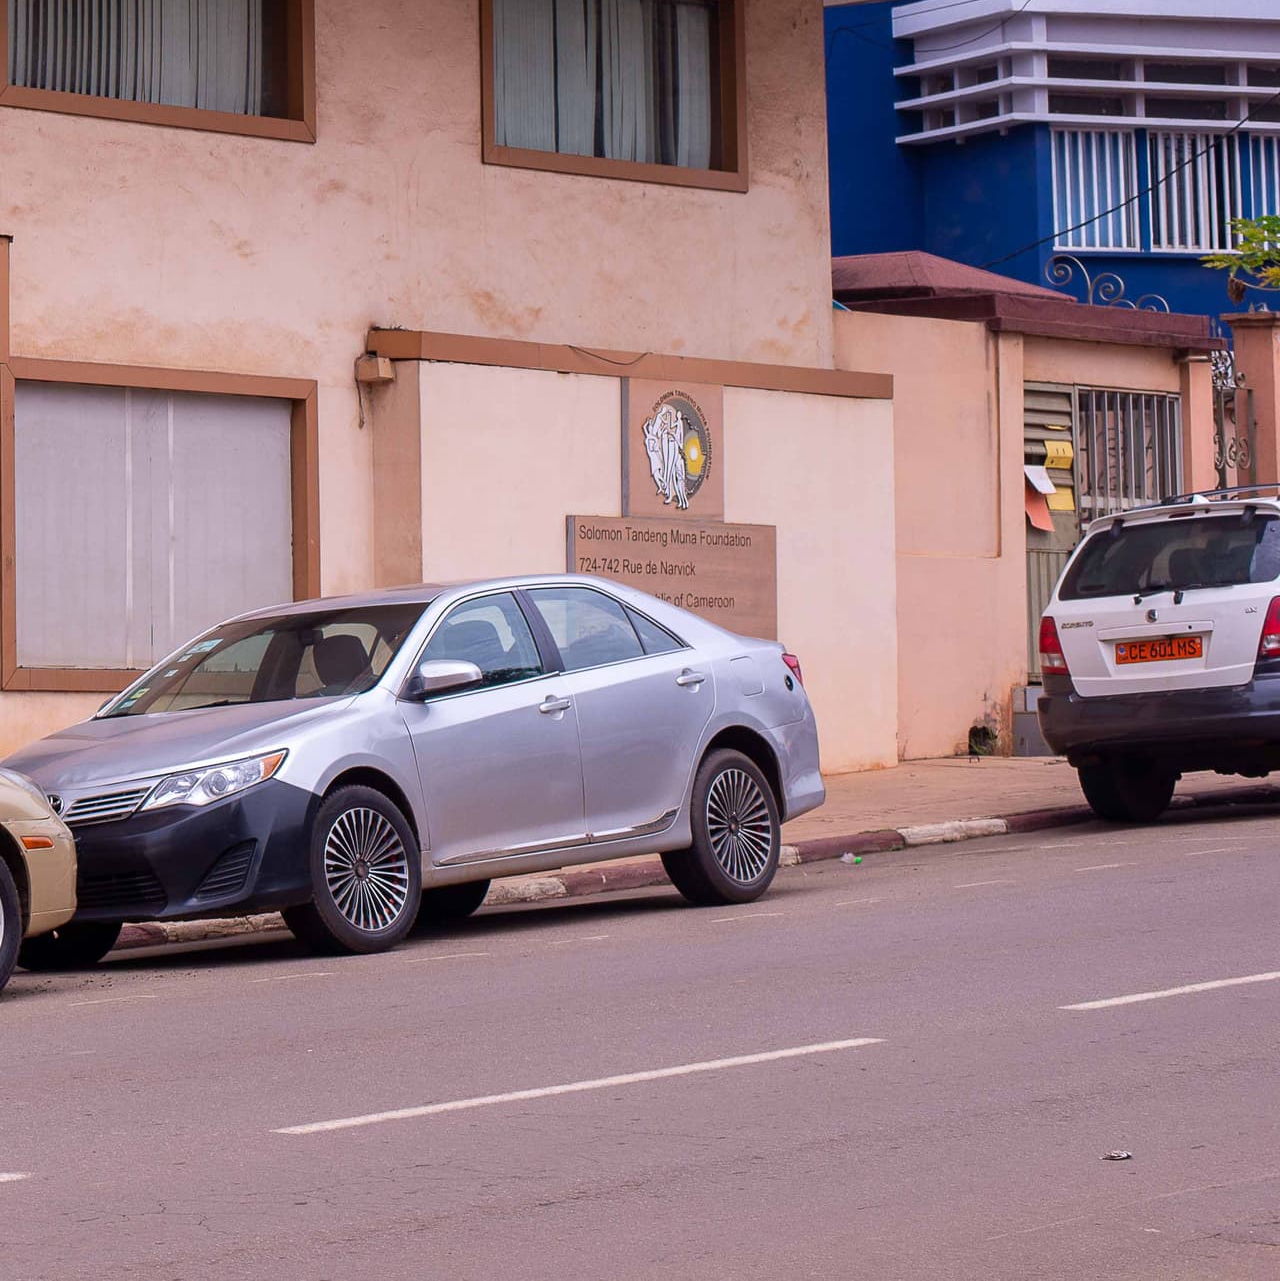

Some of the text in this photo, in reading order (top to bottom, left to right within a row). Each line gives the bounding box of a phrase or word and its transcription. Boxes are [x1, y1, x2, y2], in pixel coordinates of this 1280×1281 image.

[578, 524, 752, 547] Solomon Tandeng Muna Foundation
[578, 557, 696, 576] 724-742 Rue de Narvick
[674, 593, 683, 607] of
[686, 592, 735, 608] Cameroon
[1129, 639, 1197, 660] CE 601 MS
